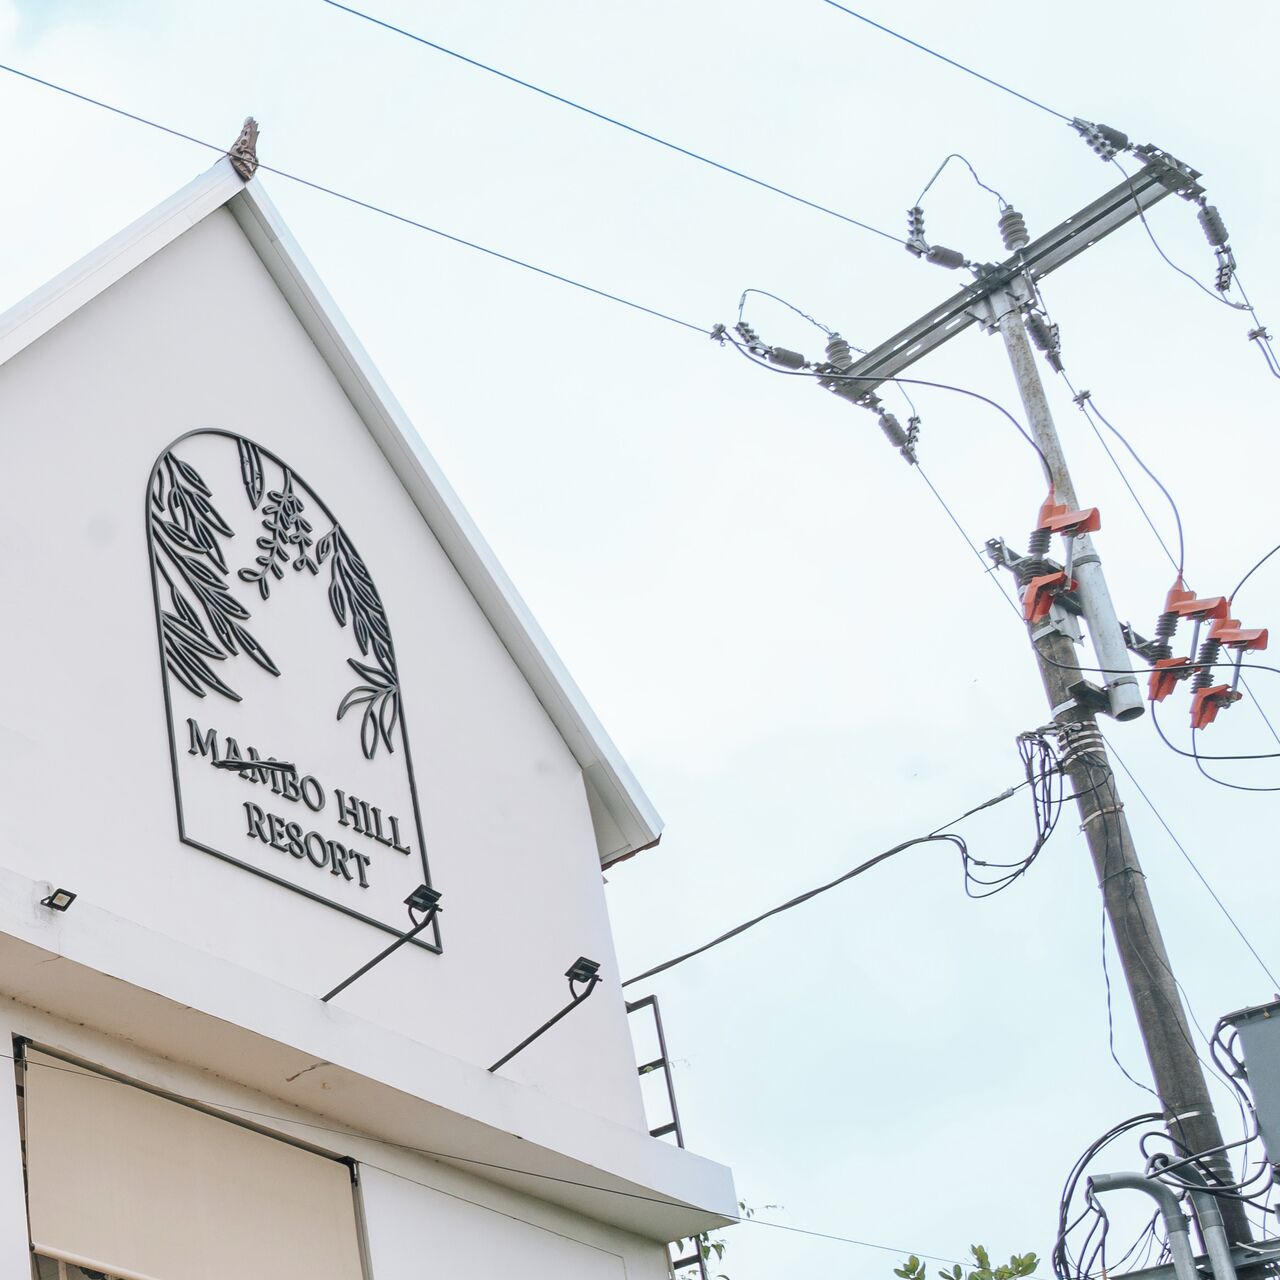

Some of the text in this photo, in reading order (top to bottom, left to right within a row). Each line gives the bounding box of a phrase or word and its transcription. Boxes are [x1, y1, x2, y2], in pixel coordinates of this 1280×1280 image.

[186, 717, 411, 855] MAMBO HILL
[242, 801, 371, 889] RESORT
